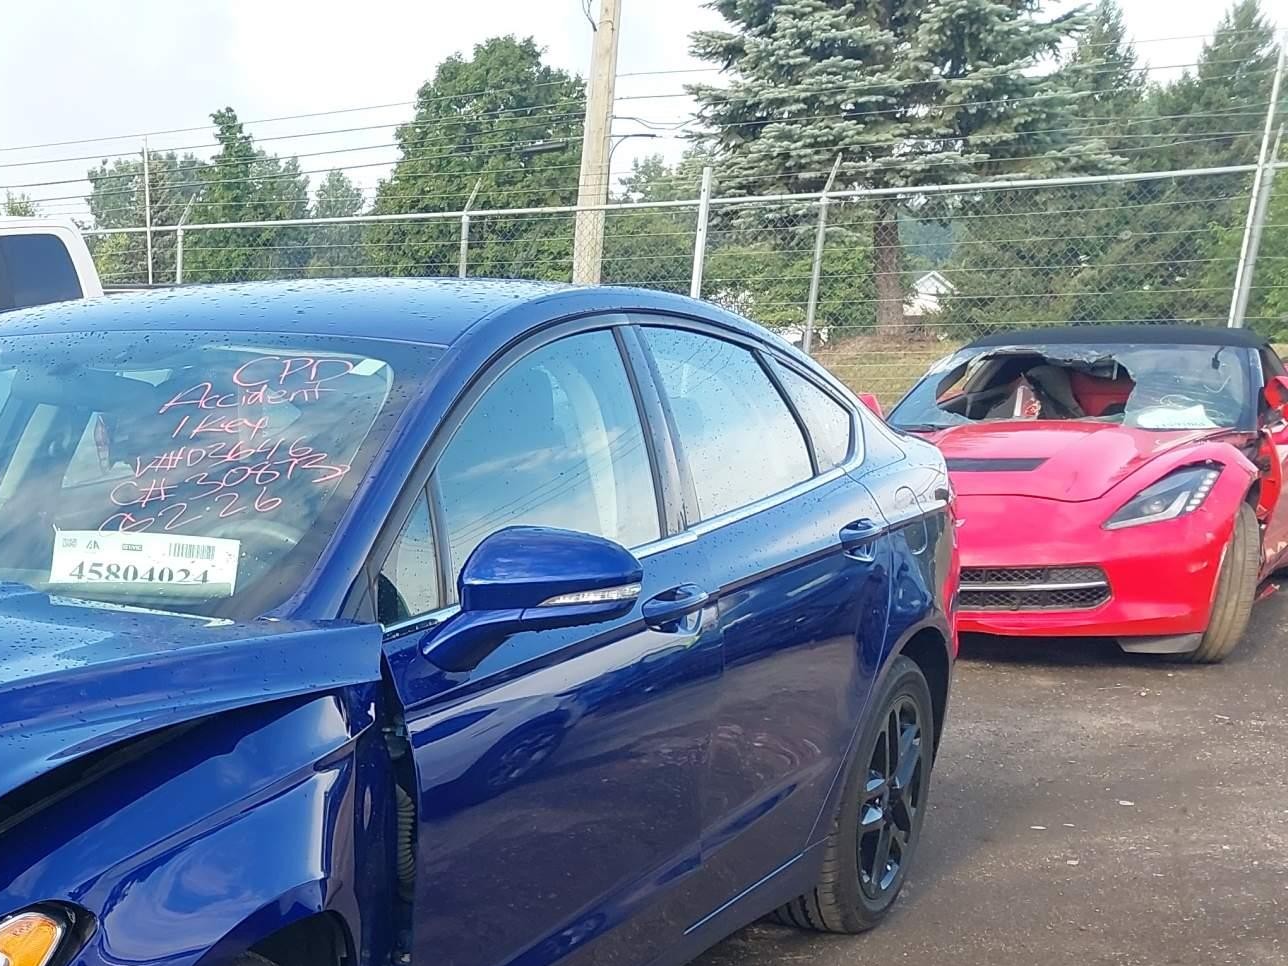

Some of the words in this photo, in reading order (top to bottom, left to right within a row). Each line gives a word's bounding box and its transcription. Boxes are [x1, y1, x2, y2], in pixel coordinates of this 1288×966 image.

[232, 357, 354, 387] CPD
[159, 381, 336, 414] Accident
[189, 415, 269, 440] Key
[69, 560, 210, 584] 45804024
